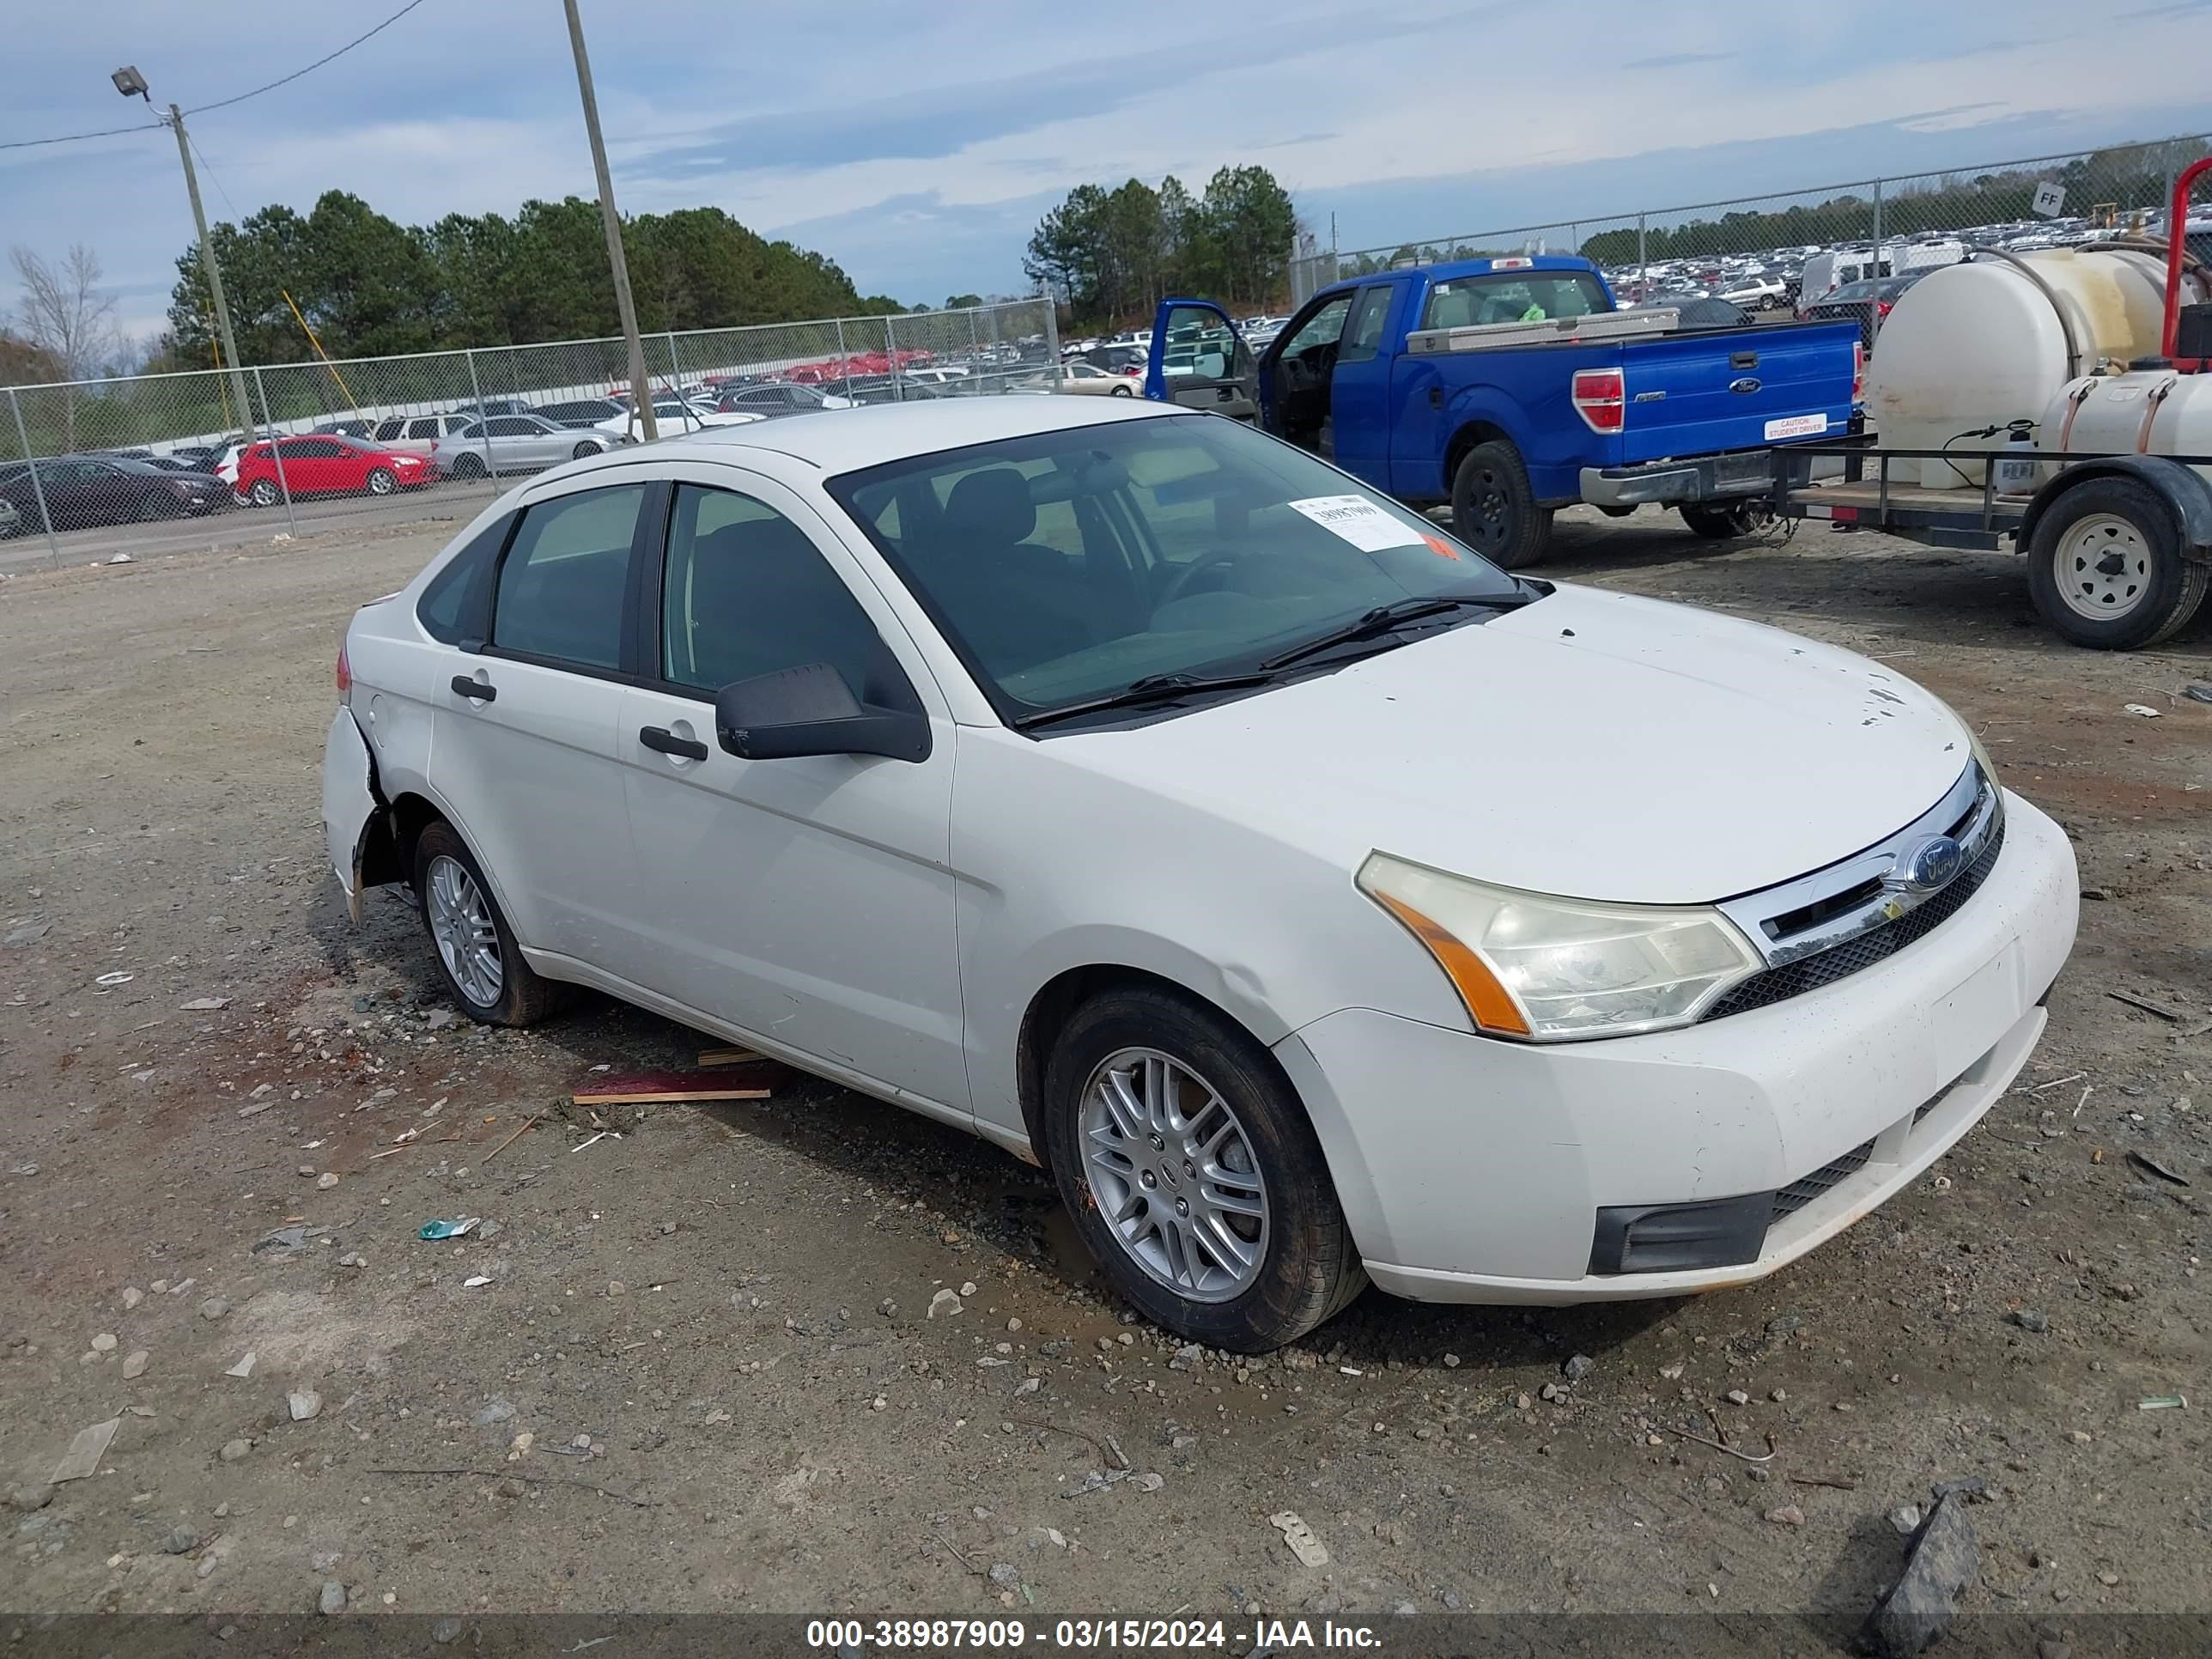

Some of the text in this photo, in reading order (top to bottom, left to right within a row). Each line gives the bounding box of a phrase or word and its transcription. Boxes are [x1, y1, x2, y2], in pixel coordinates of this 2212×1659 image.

[2039, 191, 2058, 206] FF
[1769, 423, 1822, 437] STUDENT DRIVER
[1314, 505, 1377, 522] 38987909
[1925, 845, 1954, 880] Ford
